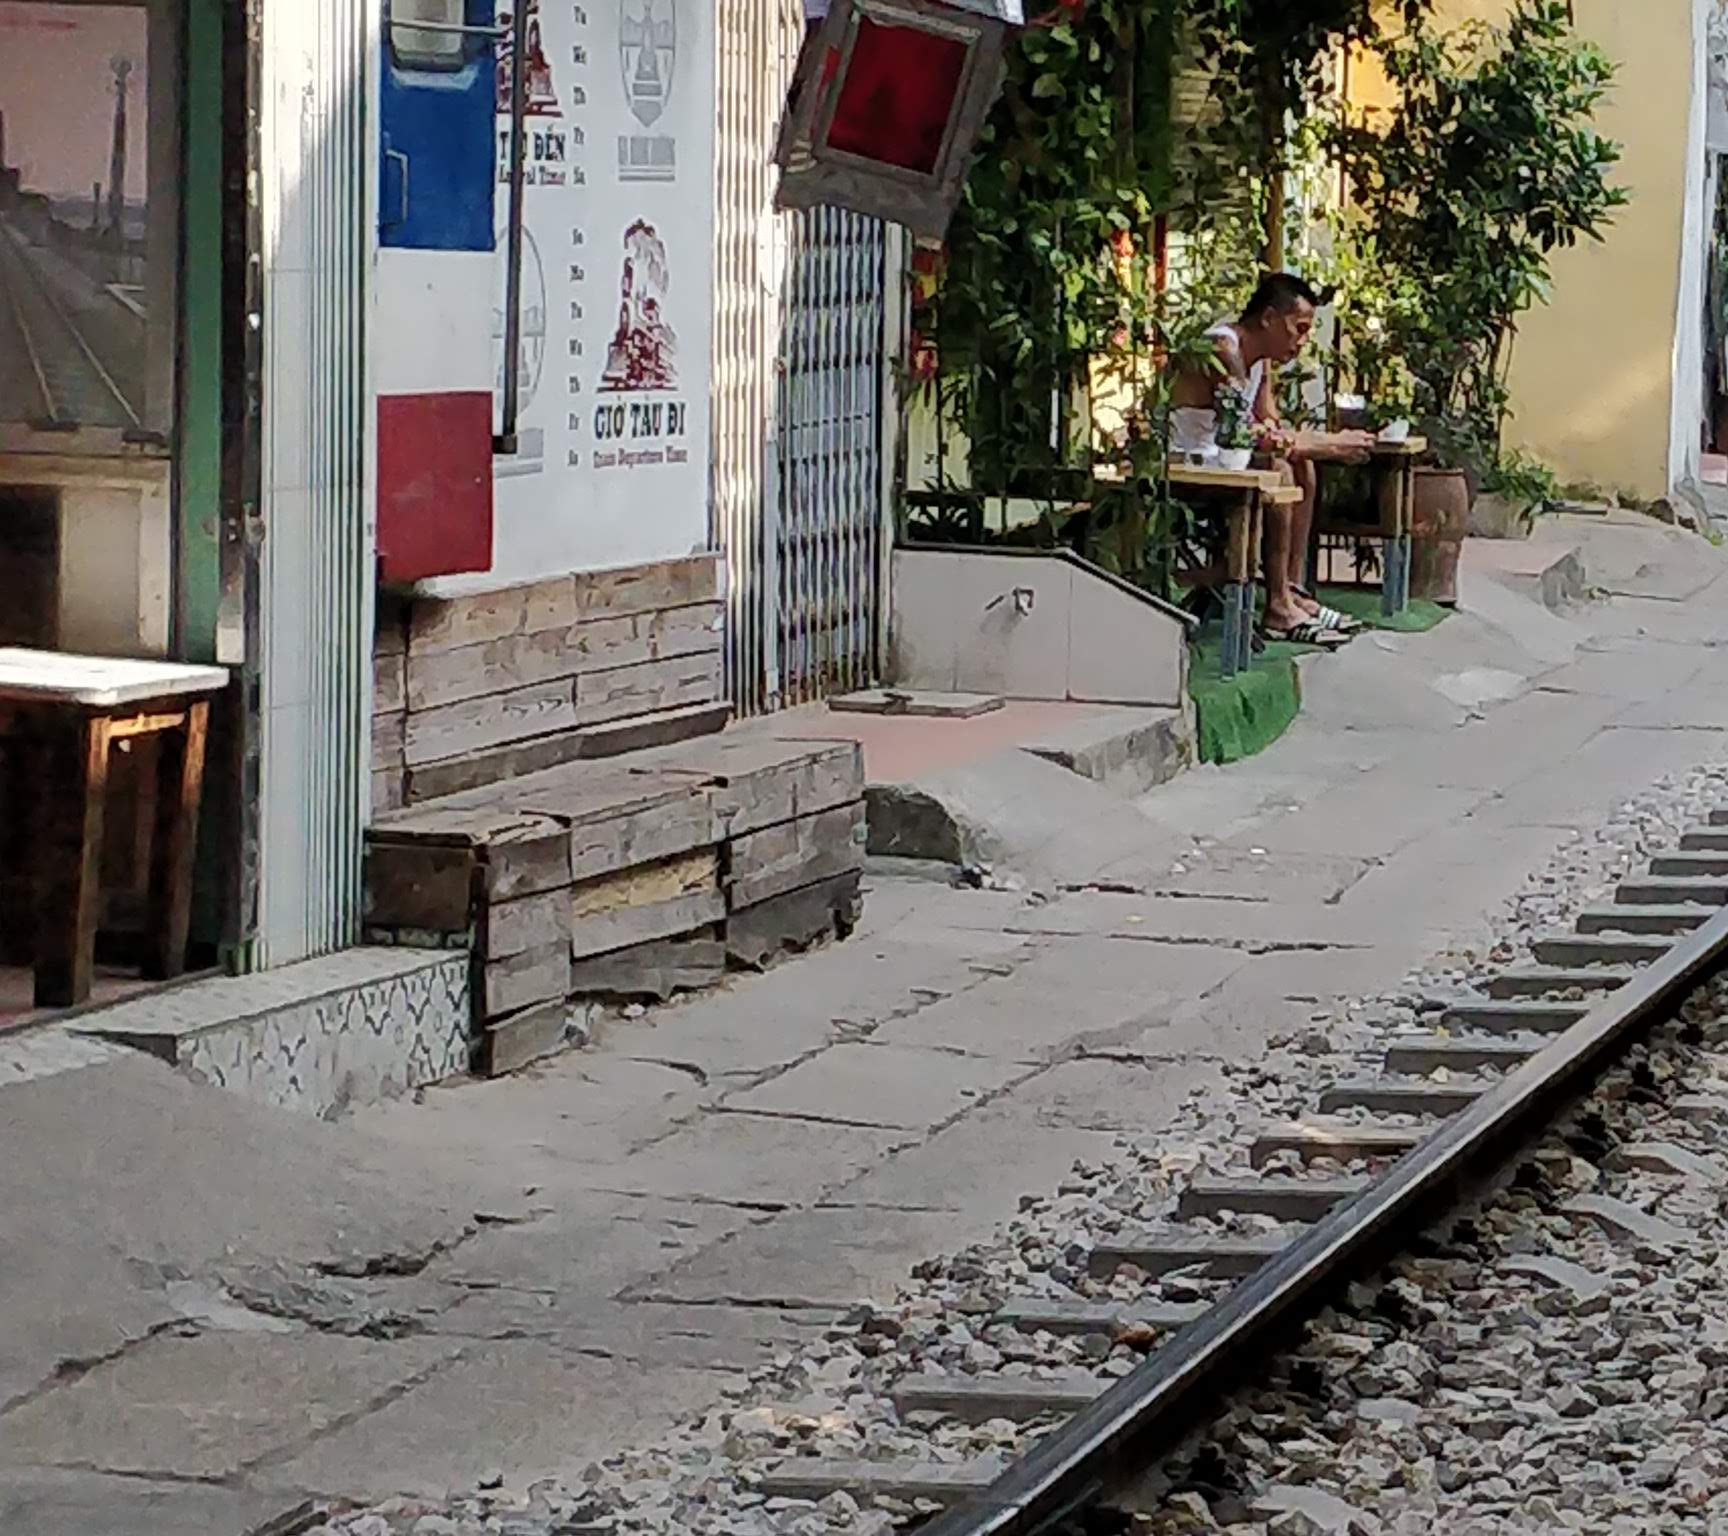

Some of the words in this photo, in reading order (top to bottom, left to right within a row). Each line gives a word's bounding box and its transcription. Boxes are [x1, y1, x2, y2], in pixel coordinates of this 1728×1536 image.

[594, 395, 627, 439] GIỜ
[630, 394, 661, 439] TÀU
[667, 402, 686, 437] ĐI
